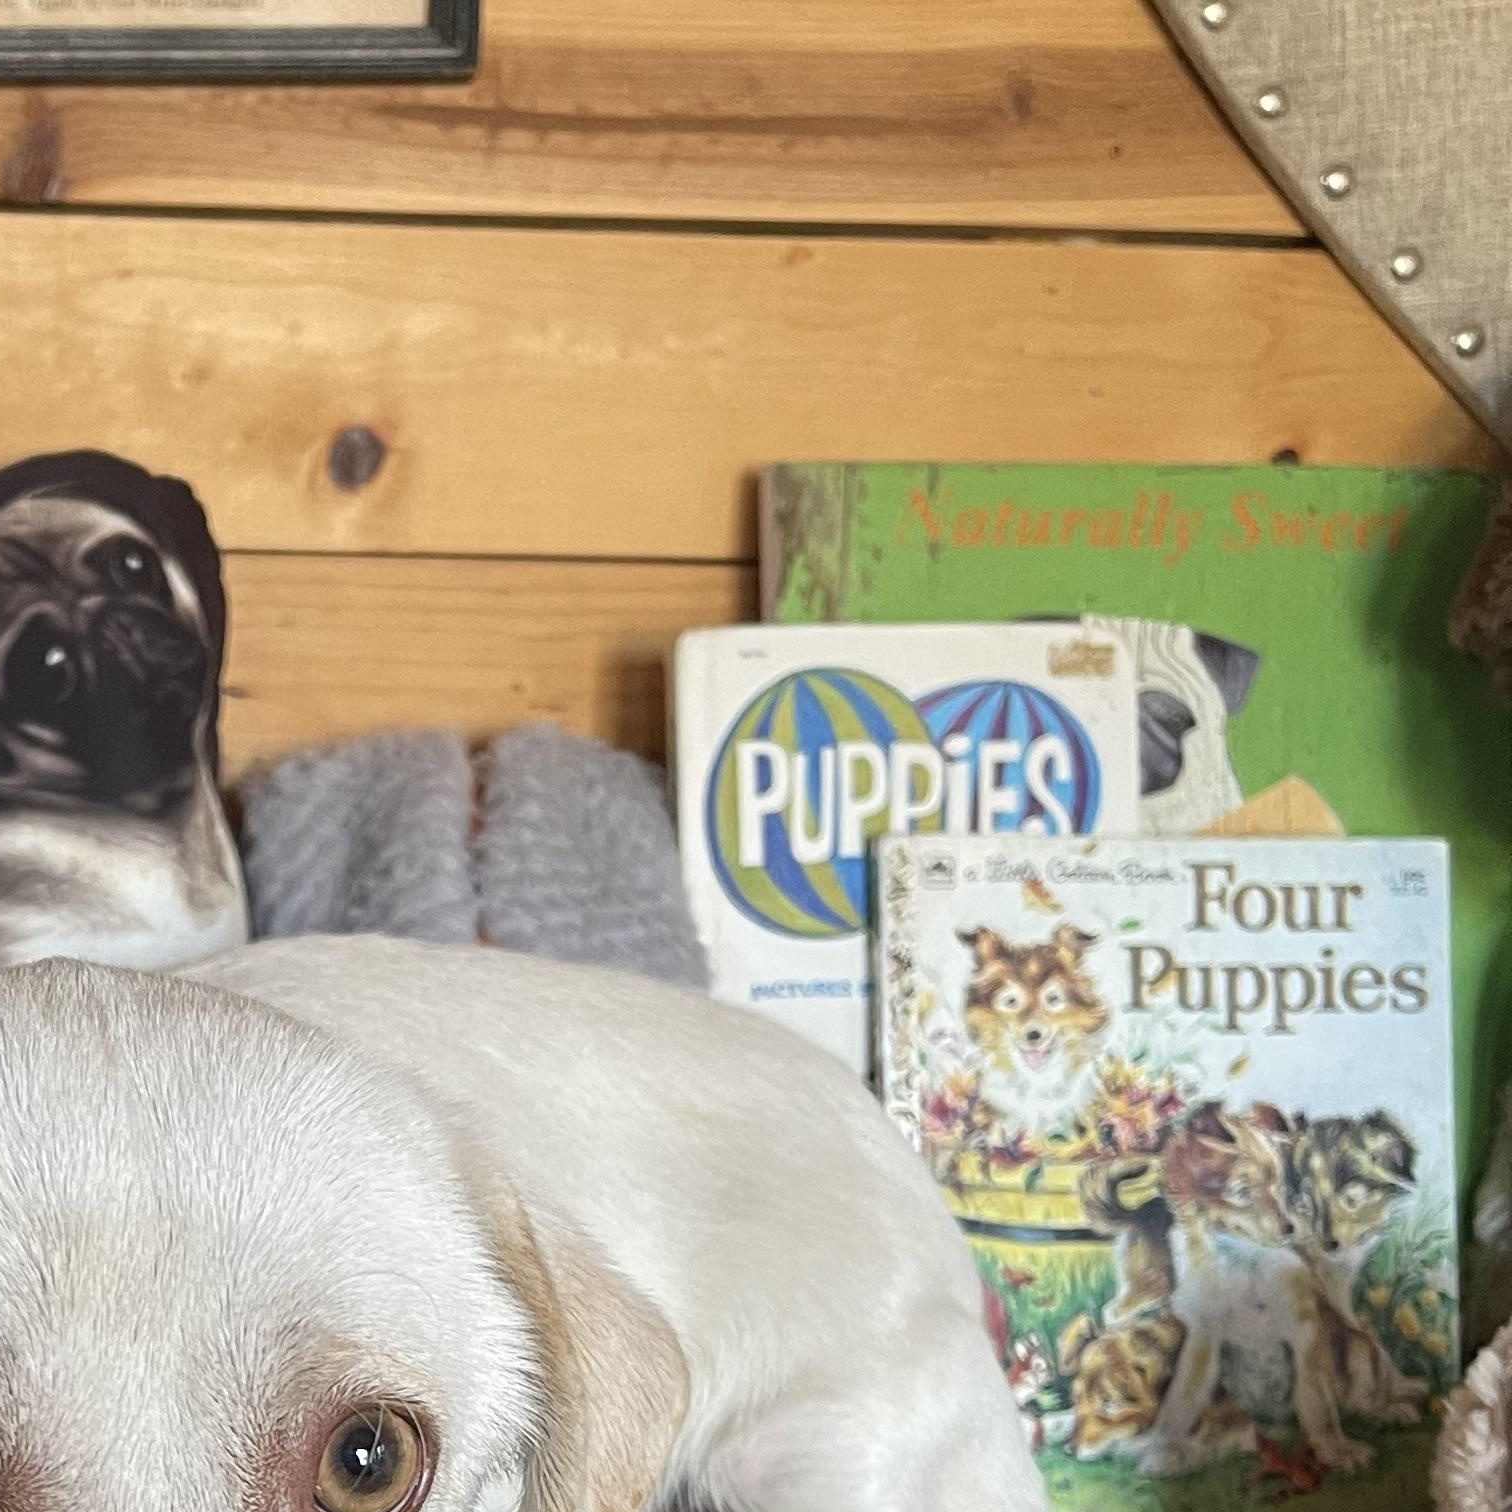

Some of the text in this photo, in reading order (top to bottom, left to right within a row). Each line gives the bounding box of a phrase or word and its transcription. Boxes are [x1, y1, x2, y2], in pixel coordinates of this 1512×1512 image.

[898, 488, 1410, 567] Naturally Sweet
[1185, 859, 1364, 933] Four
[1121, 942, 1430, 1036] Puppies
